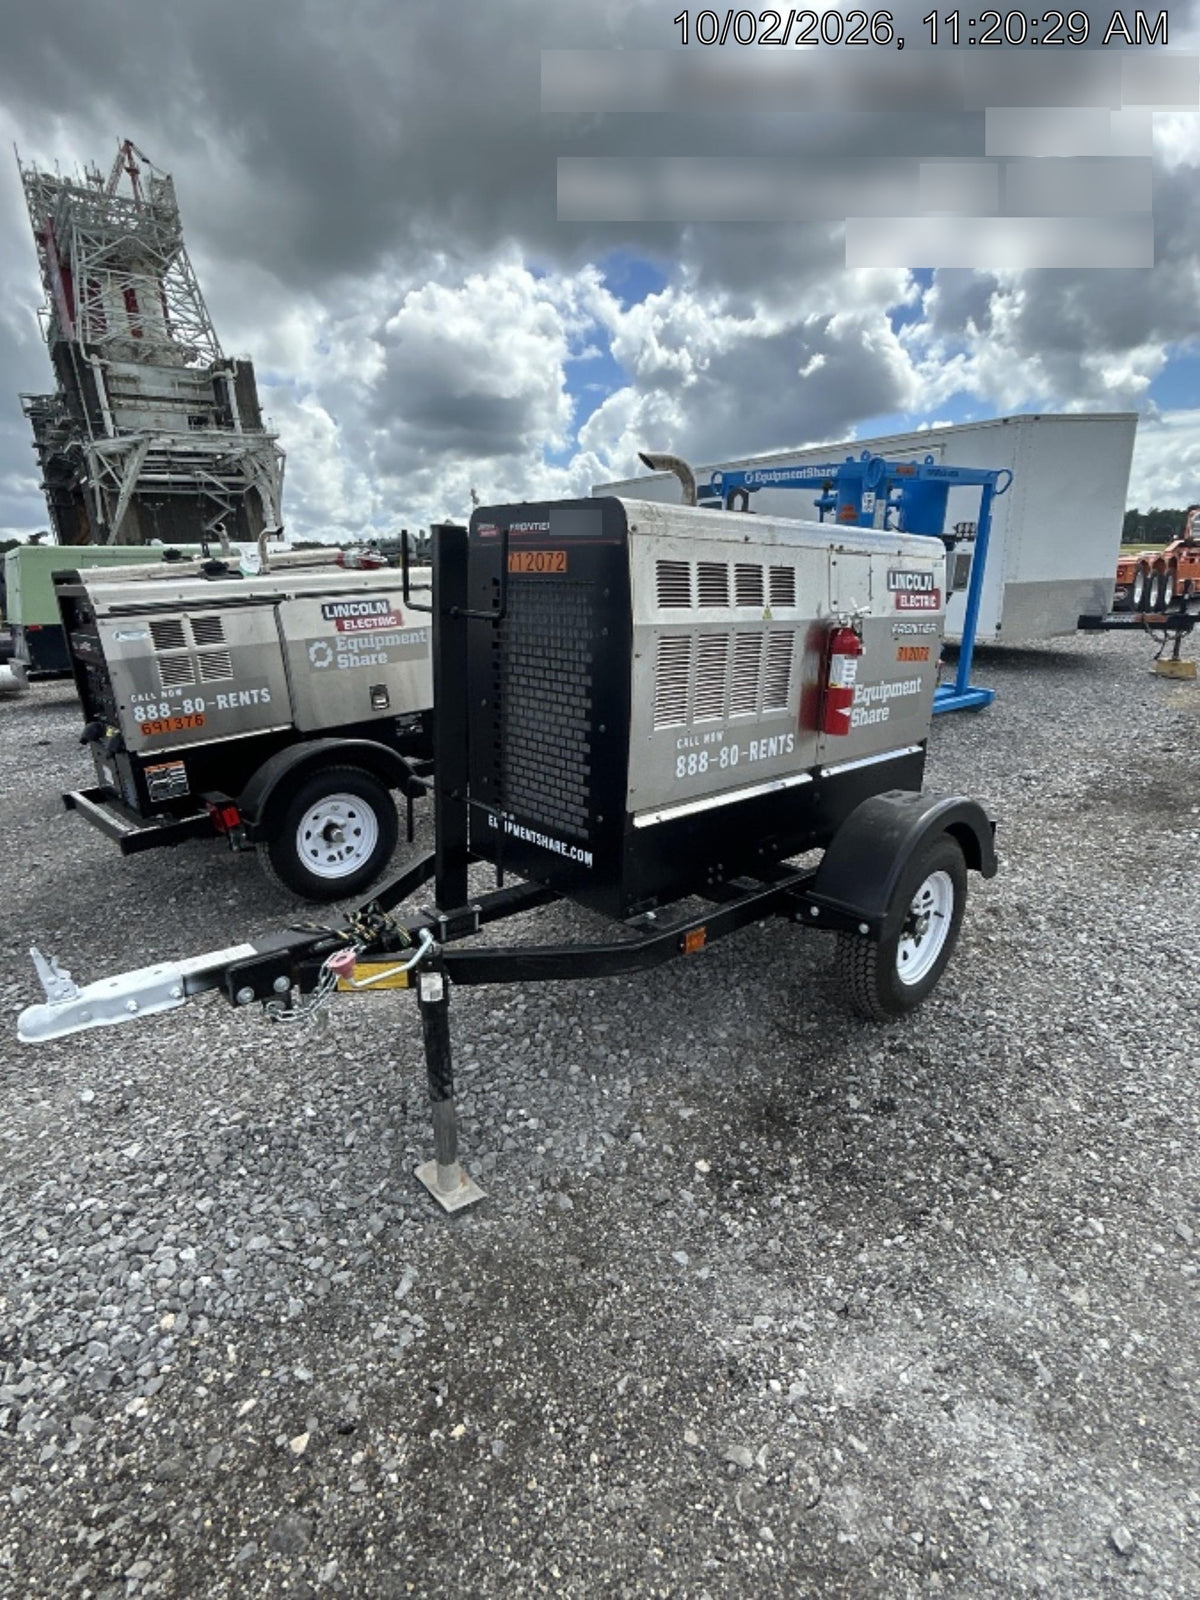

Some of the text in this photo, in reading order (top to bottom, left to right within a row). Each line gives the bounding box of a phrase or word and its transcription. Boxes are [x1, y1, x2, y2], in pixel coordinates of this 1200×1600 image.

[509, 522, 550, 531] FRONTIE
[889, 573, 932, 591] LINCOLN
[325, 601, 389, 618] LINCOLN
[899, 595, 936, 608] ELECTRIC
[343, 616, 397, 631] ELECTRIC
[892, 623, 937, 634] FRONTIER
[336, 630, 428, 653] Equipment
[337, 652, 388, 669] Share
[130, 688, 183, 704] CALL NOW
[853, 677, 922, 707] Equipment
[134, 688, 271, 722] 888-80-RENTS
[142, 714, 205, 736] 691376
[851, 707, 890, 728] Share
[676, 730, 725, 750] CALL NOW
[676, 733, 795, 778] 888-80-RENTS
[488, 814, 593, 867] EIPMENTSHARE.COM
